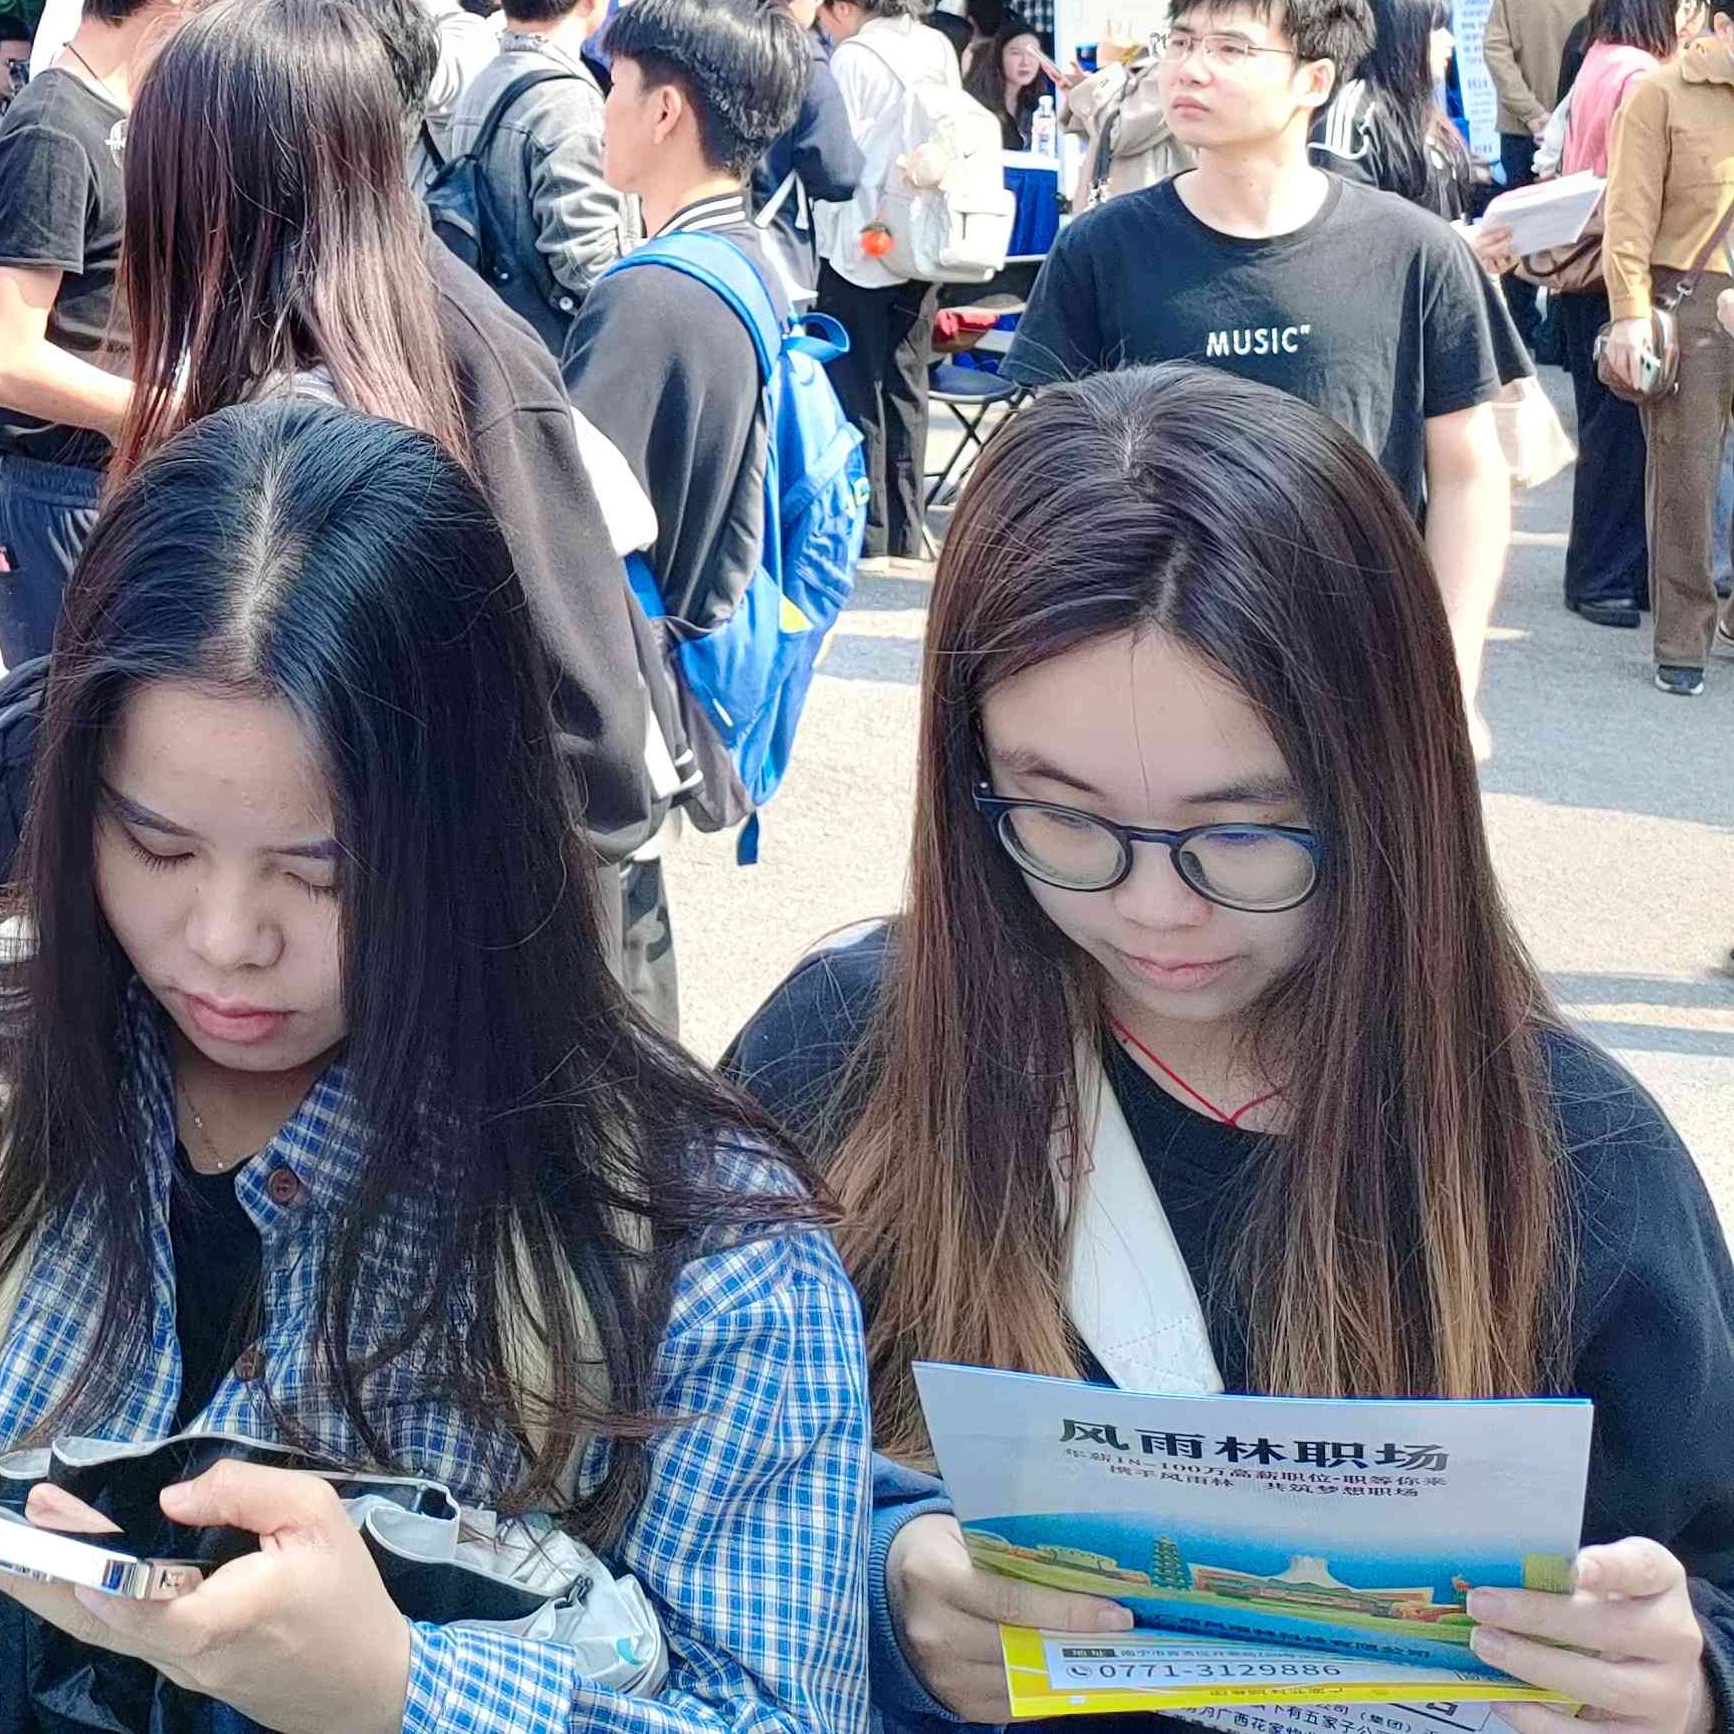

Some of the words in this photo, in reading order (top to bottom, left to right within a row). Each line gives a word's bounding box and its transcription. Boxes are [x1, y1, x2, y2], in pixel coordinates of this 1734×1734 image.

[1059, 1418, 1450, 1472] 风雨林职场
[1099, 1664, 1341, 1678] 0771-3129886
